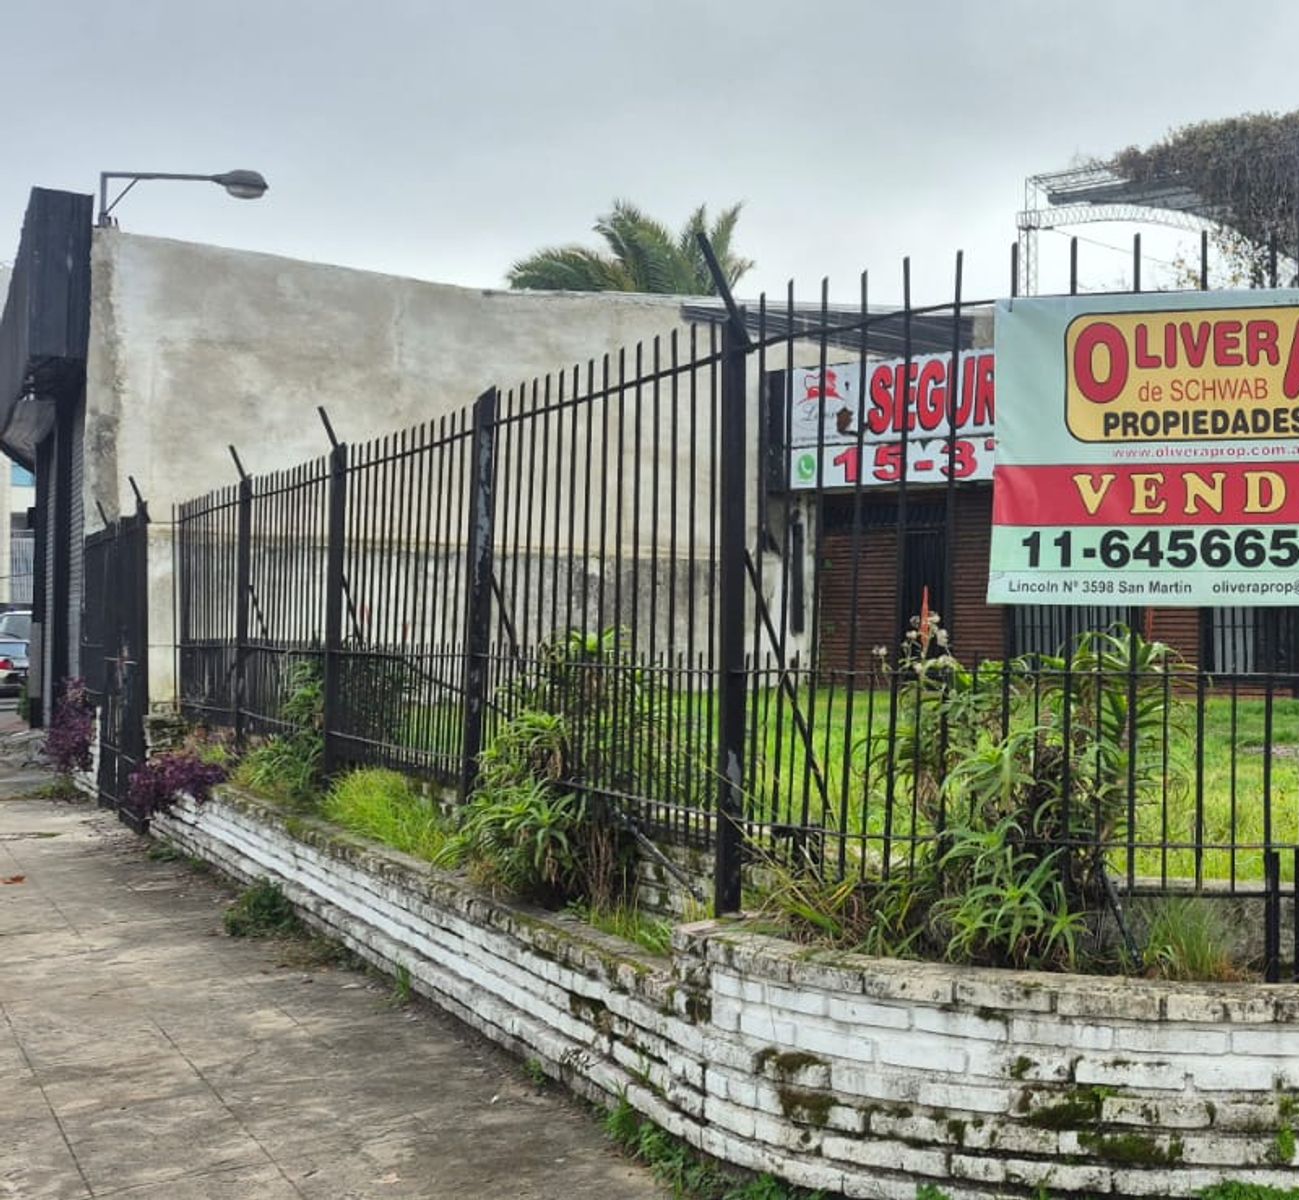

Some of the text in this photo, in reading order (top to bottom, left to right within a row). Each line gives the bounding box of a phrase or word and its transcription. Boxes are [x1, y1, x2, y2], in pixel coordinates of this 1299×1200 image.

[1138, 378, 1269, 402] de SCHWAB
[1008, 580, 1059, 593] Lincoln
[1082, 580, 1114, 594] 3598
[1118, 580, 1145, 594] San
[1149, 580, 1193, 594] Martin
